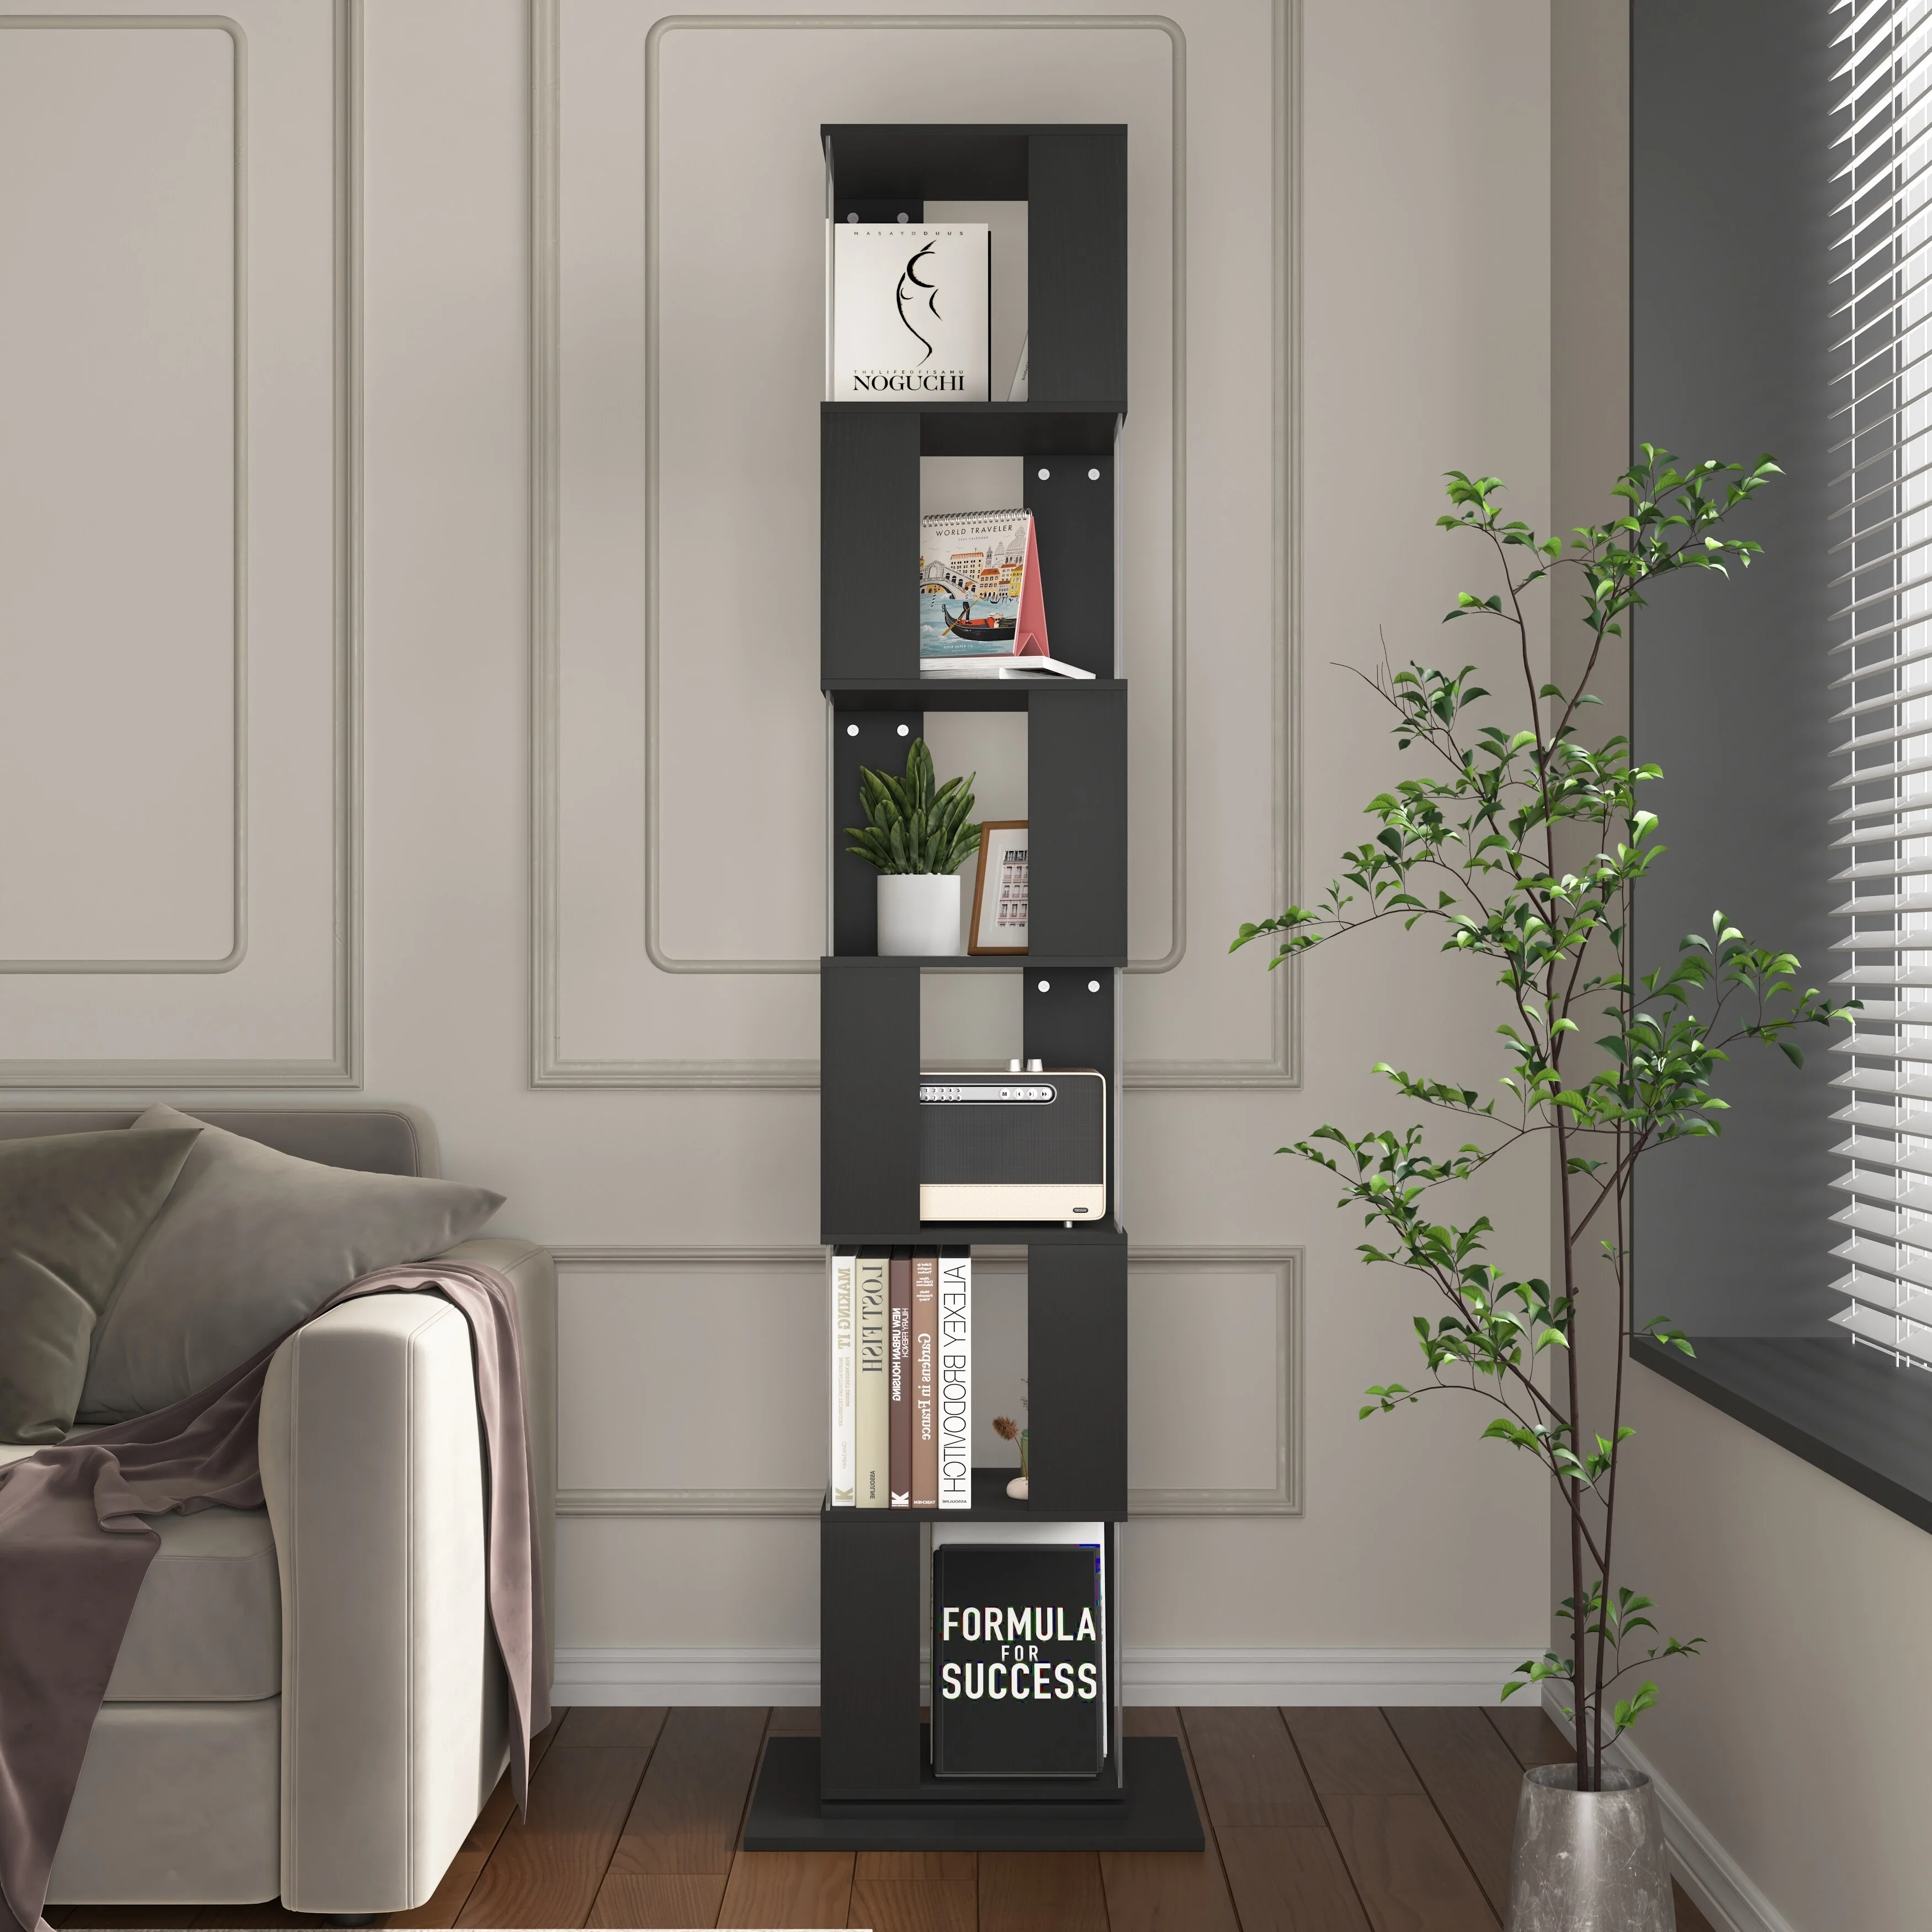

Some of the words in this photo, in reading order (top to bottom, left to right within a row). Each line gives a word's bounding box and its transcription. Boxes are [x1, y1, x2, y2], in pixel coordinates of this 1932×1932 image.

[853, 376, 964, 390] NOGUCHI
[971, 525, 1012, 533] TRAVELER
[944, 1607, 1096, 1641] FORMULA
[1002, 1645, 1038, 1661] FOR
[943, 1663, 1096, 1699] SUCCESS
